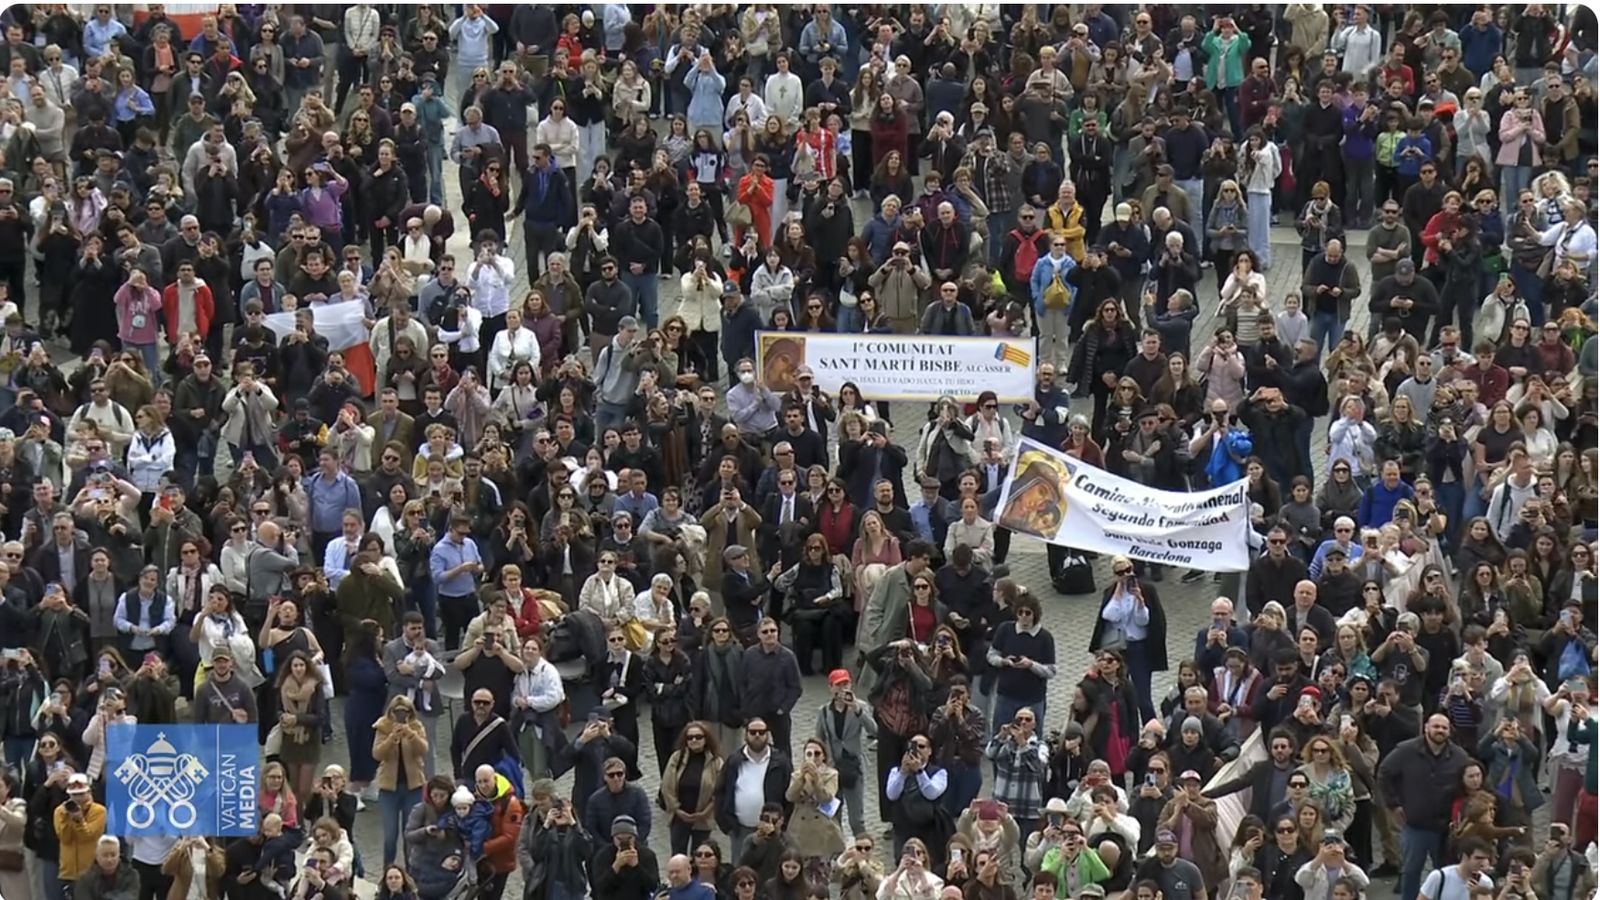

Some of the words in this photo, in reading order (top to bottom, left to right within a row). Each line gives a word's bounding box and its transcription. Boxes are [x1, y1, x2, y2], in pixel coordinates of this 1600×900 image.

[866, 342, 955, 355] COMUNITAT
[819, 358, 860, 369] SANT
[864, 356, 914, 371] MARTÍ
[919, 359, 962, 372] BISBE
[1074, 474, 1134, 504] Camino
[1092, 502, 1156, 527] Segunda
[1128, 545, 1192, 564] Barcelona
[1168, 538, 1222, 554] Gonzaga
